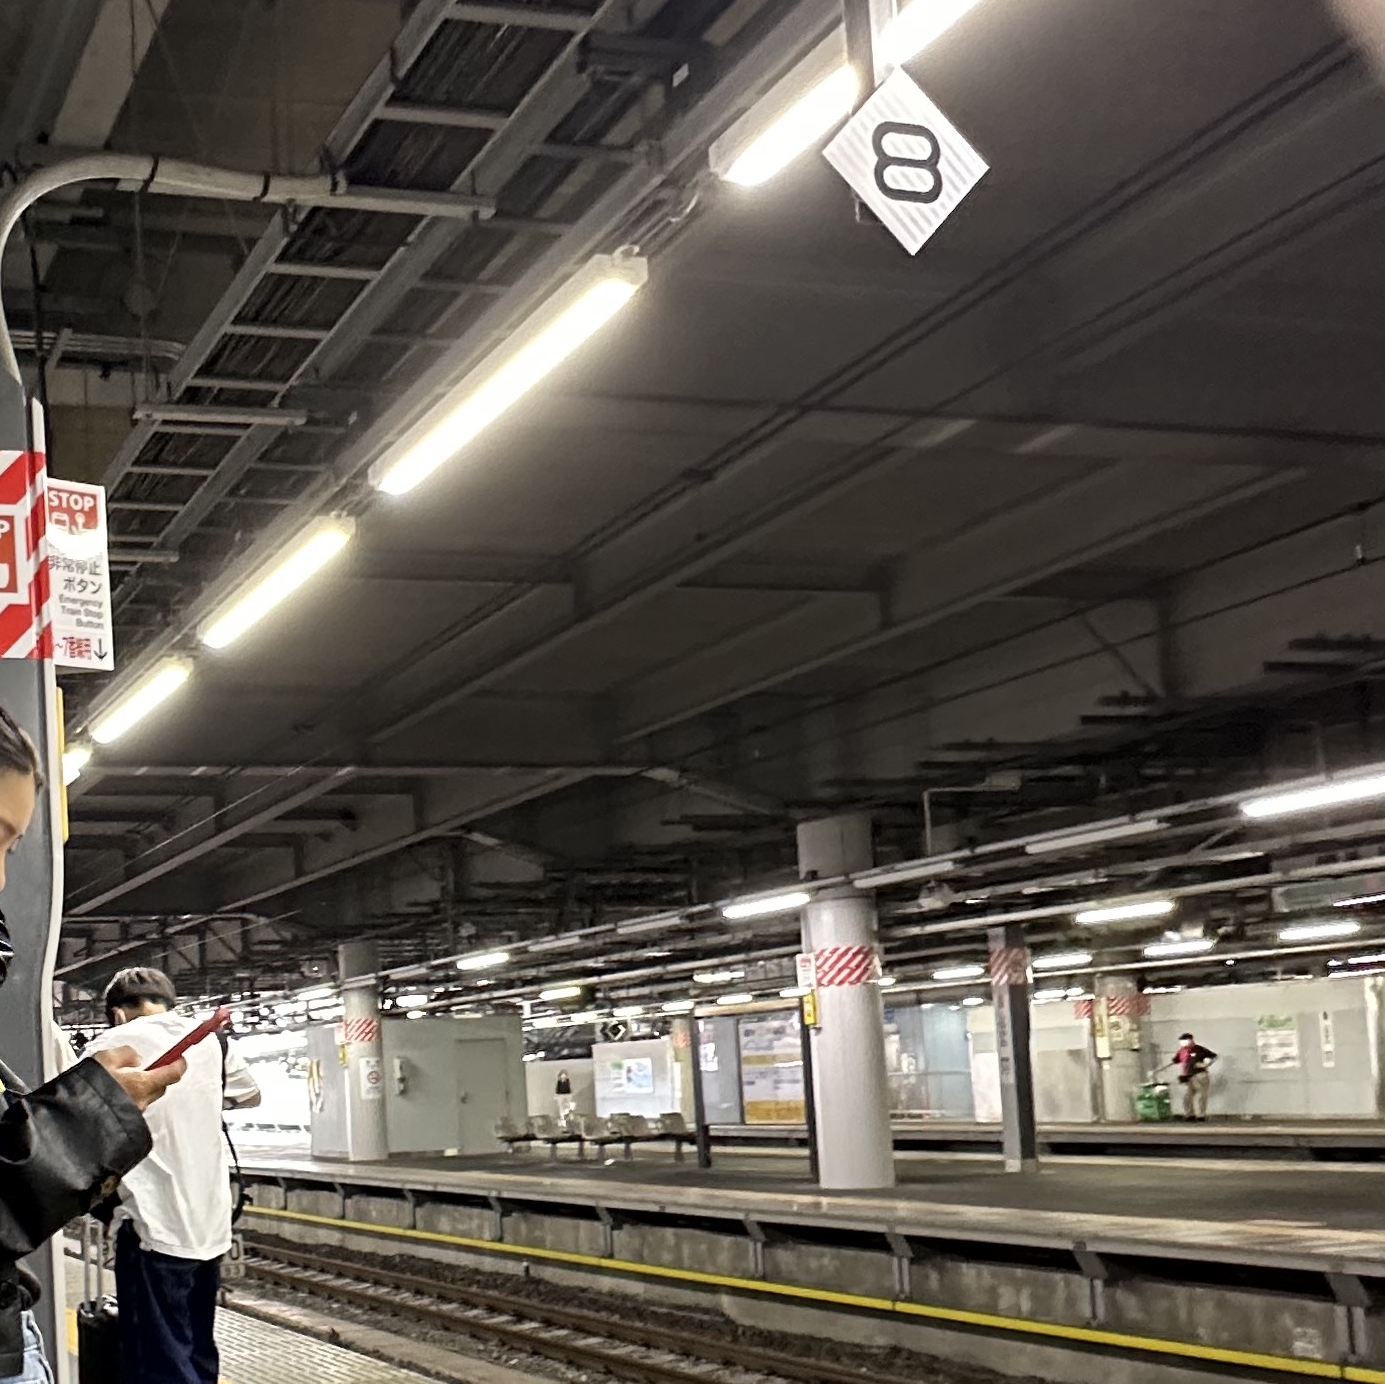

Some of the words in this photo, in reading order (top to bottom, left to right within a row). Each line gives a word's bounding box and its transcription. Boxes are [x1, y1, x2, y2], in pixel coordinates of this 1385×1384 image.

[872, 121, 943, 204] 8
[48, 491, 95, 512] STOP
[63, 577, 103, 595] ボタン
